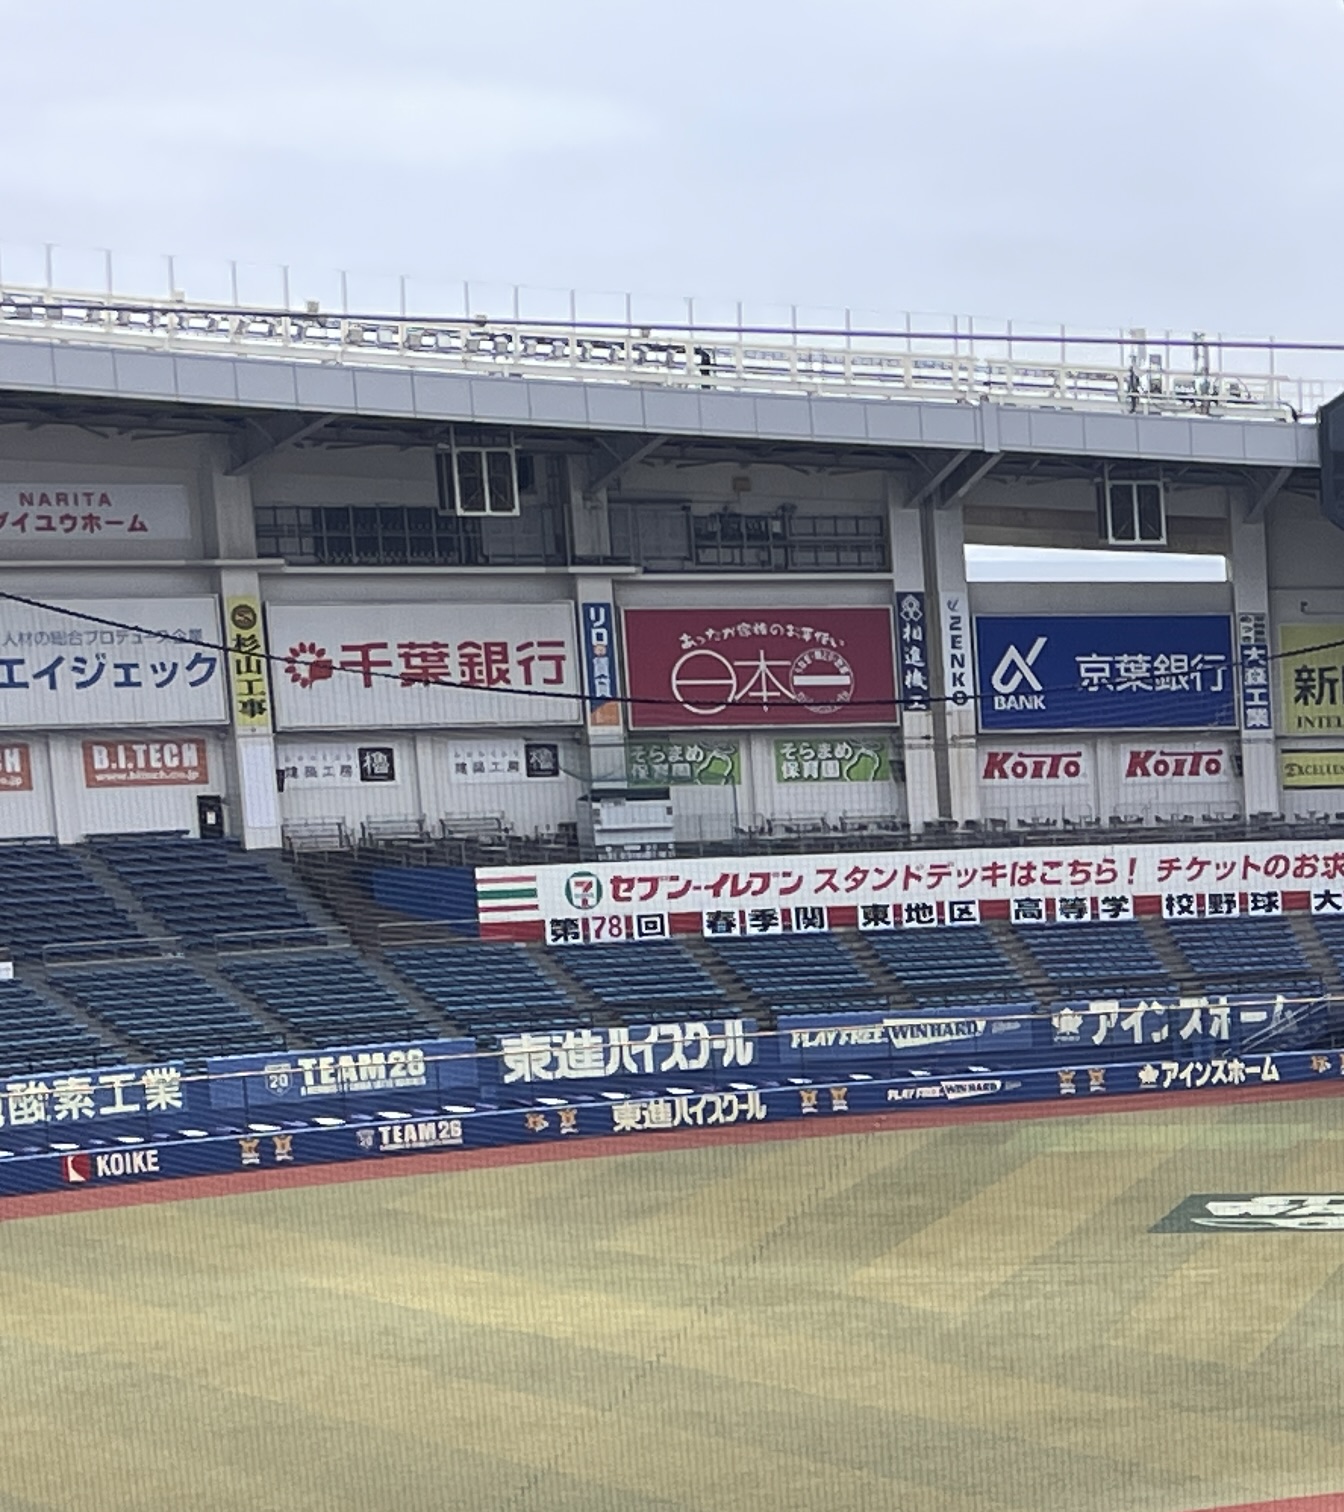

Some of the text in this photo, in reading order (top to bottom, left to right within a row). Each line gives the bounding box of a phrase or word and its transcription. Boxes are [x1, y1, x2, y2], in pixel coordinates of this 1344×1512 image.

[19, 491, 113, 508] NARITA
[0, 653, 218, 690] エイジェック
[231, 633, 268, 719] 杉山工事
[340, 640, 567, 688] 千葉銀行
[1074, 652, 1227, 692] 京葉銀行
[994, 695, 1047, 711] BANK
[93, 743, 199, 770] B.I.TECH
[631, 743, 704, 763] そらまめ
[779, 742, 853, 761] そらまめ
[550, 914, 668, 943] 第78回
[502, 1018, 754, 1084] 東進ハイスクール
[1161, 1055, 1281, 1089] アインスホーム
[0, 1066, 184, 1128] 酸素工業
[612, 1090, 768, 1133] 東進ハイスクール
[96, 1150, 161, 1178] KOIKE
